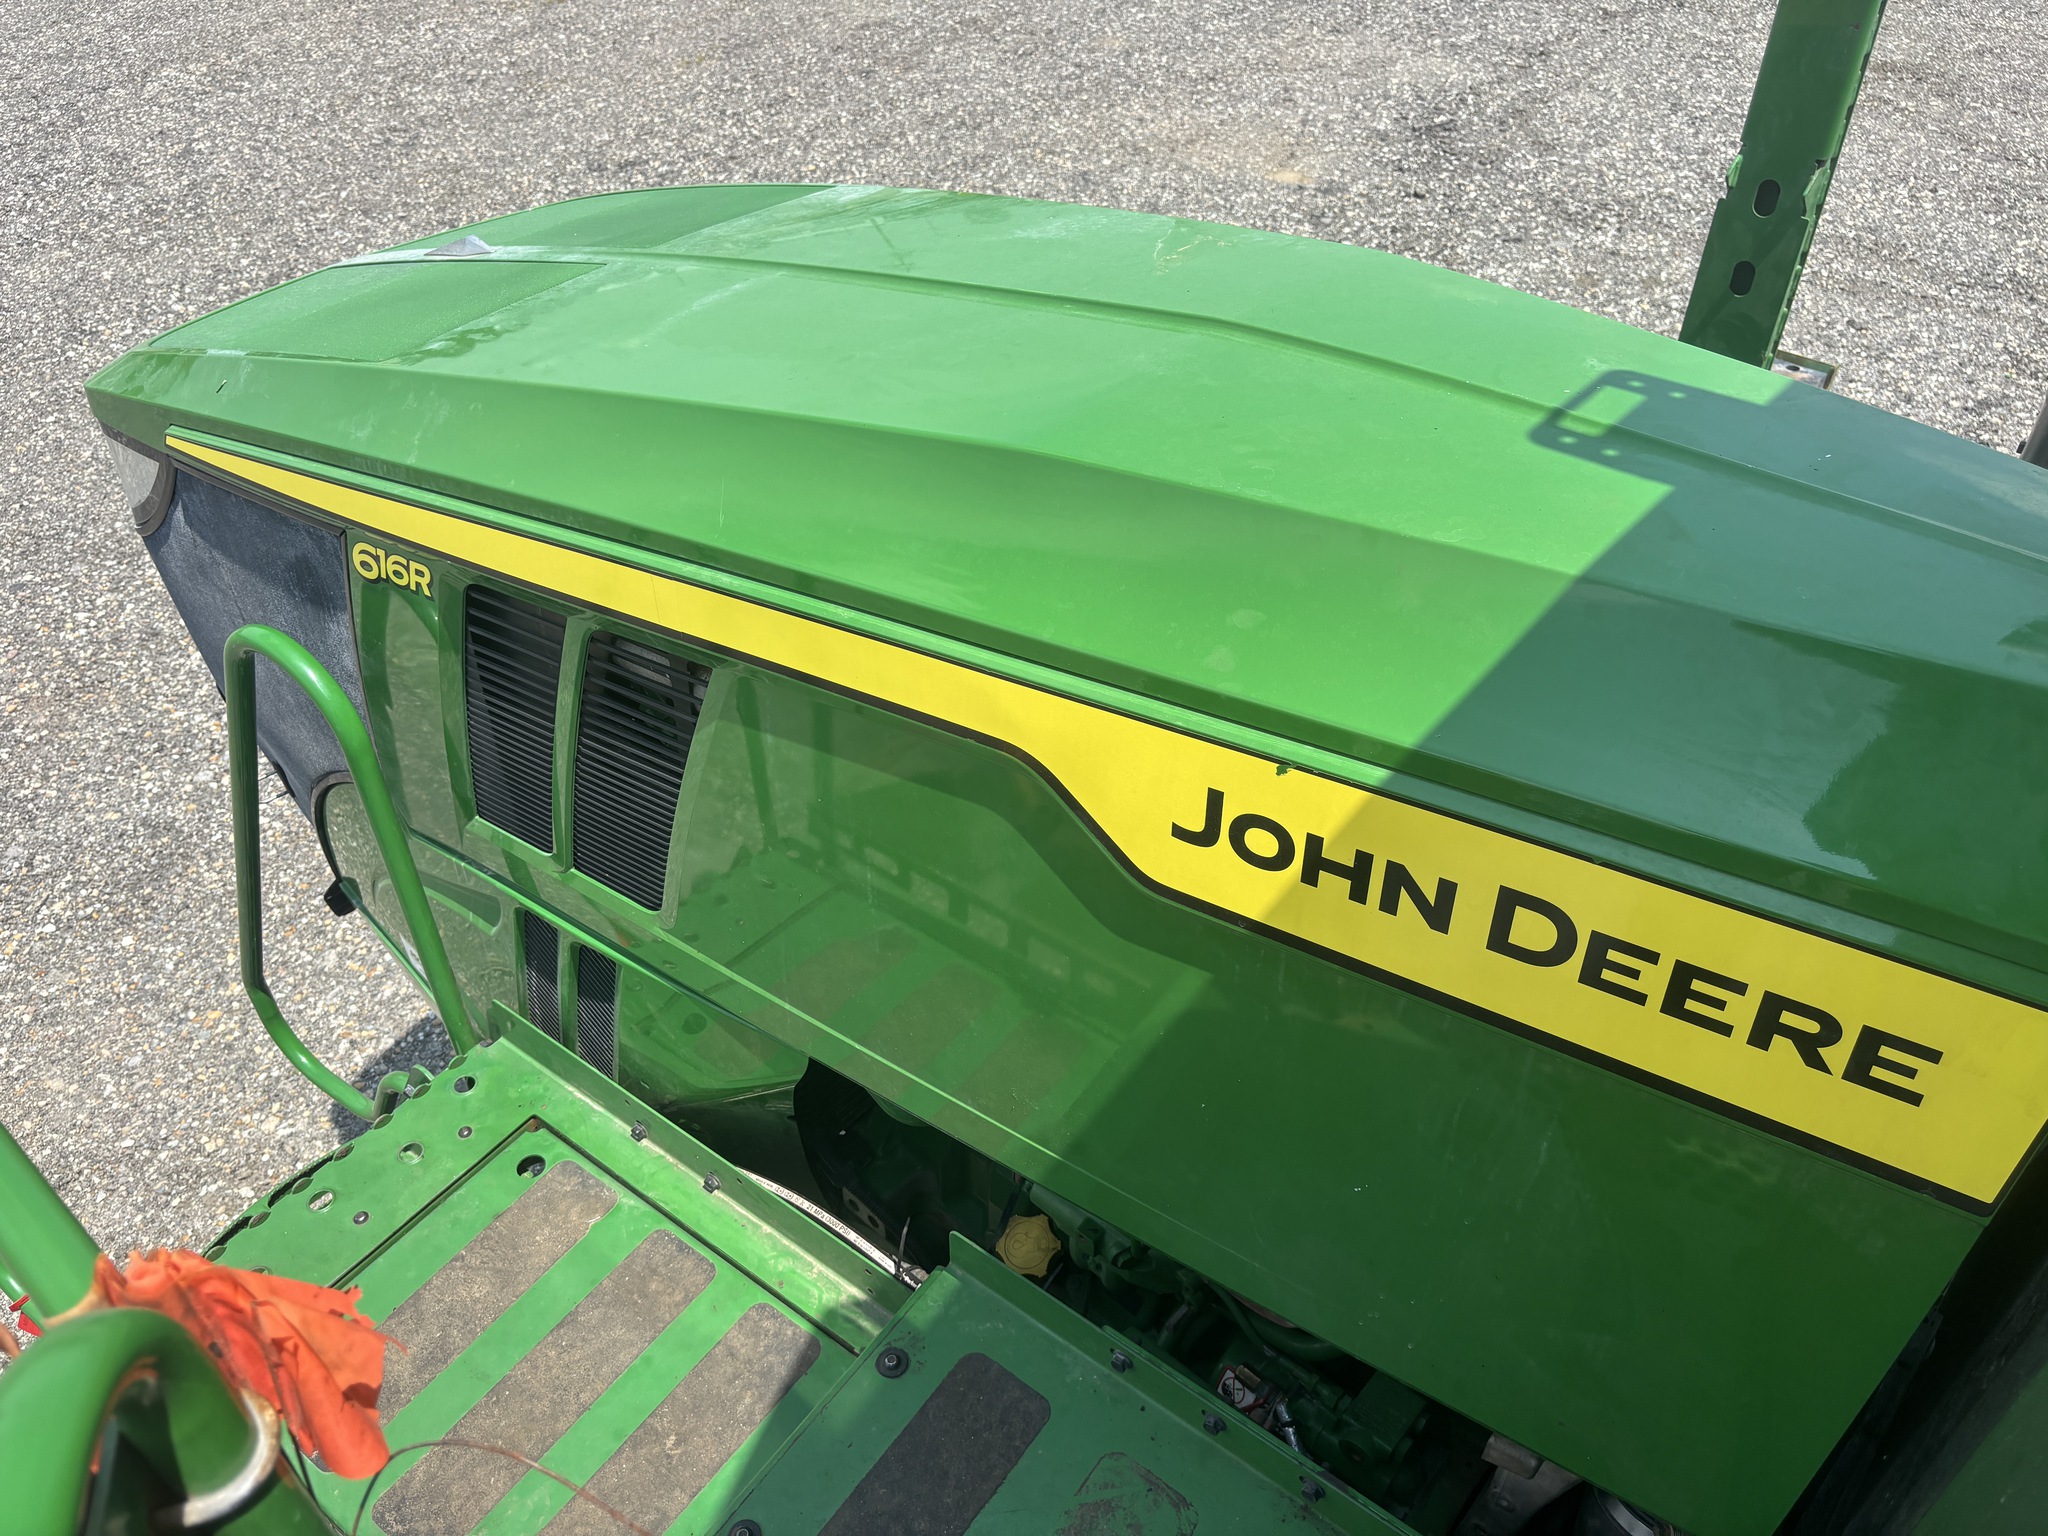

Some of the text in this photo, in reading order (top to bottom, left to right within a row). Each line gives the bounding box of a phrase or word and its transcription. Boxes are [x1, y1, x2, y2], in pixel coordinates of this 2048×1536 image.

[352, 541, 433, 600] 616R
[1171, 787, 1945, 1108] JOHN DEERE
